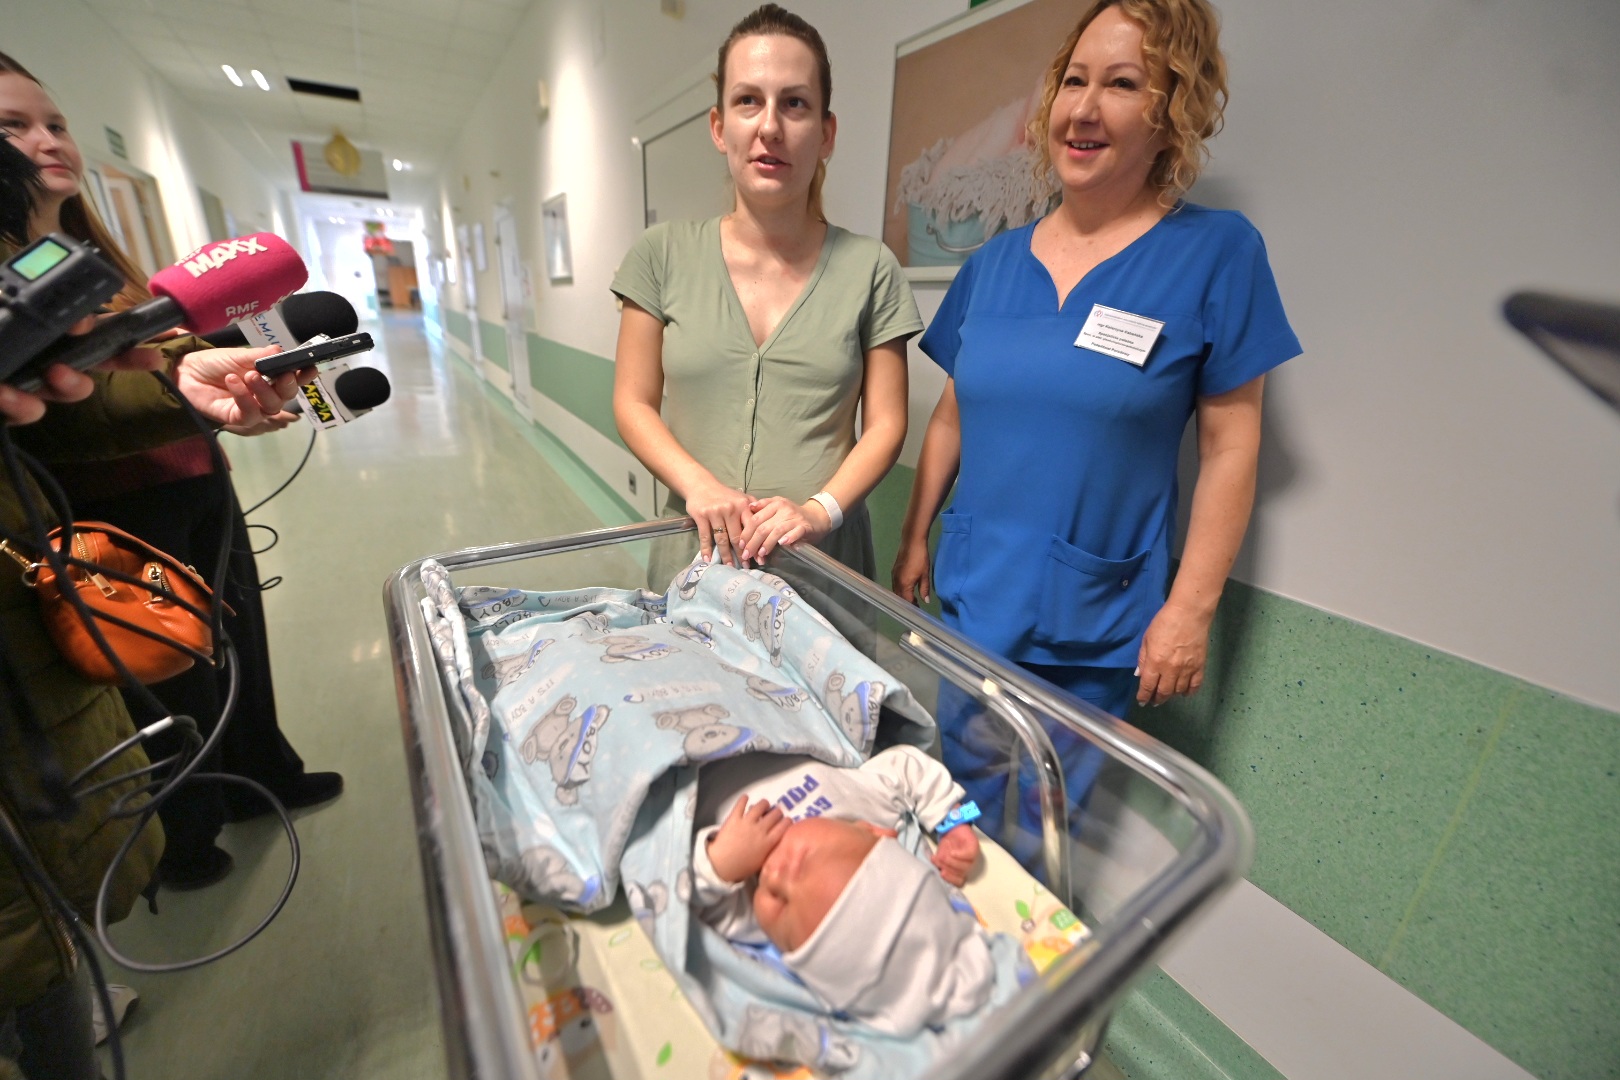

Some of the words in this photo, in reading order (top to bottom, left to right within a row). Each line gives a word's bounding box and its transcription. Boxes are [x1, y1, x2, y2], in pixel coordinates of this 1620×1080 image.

[183, 237, 268, 278] MAXX
[225, 301, 259, 317] RMF
[254, 313, 285, 352] EMA
[478, 596, 512, 619] BOY
[774, 608, 783, 644] BOY
[536, 678, 555, 696] IT'S
[777, 694, 799, 707] BOY
[576, 725, 596, 774] BOY
[770, 774, 820, 812] POL
